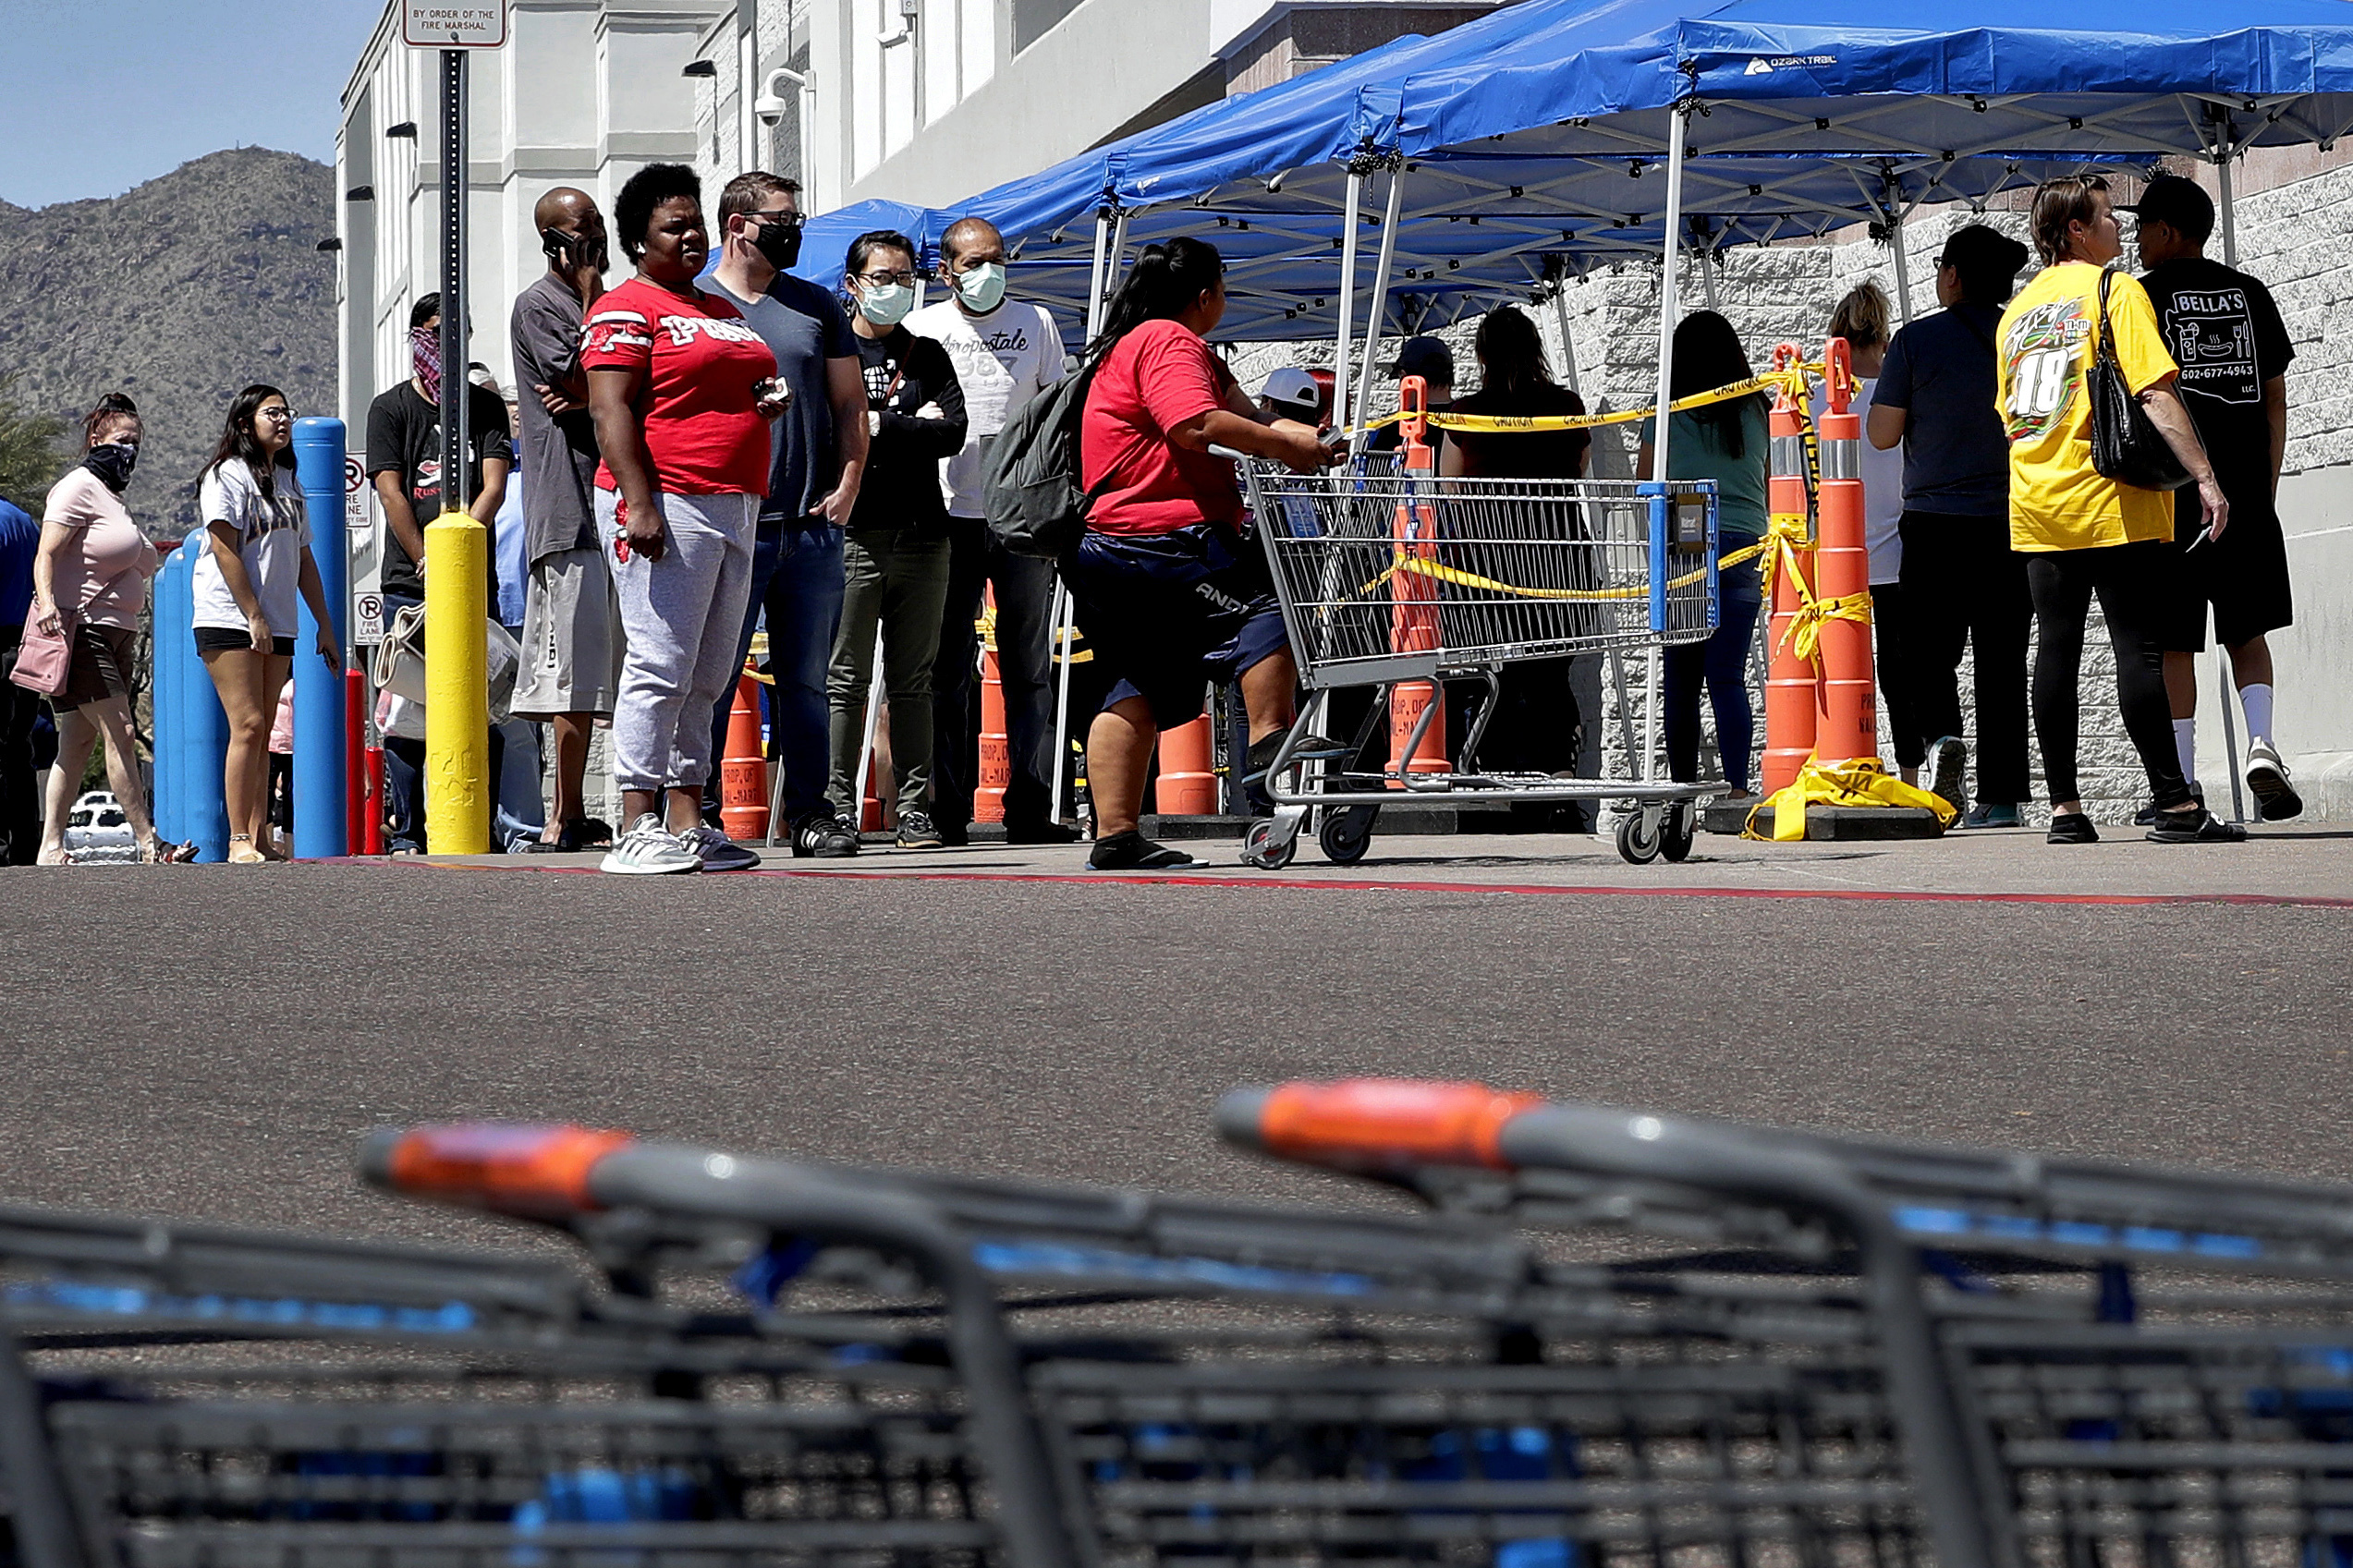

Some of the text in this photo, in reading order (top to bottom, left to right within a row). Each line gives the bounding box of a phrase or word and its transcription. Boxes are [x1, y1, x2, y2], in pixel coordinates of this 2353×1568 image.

[413, 10, 494, 18] BY ORDER OF THE
[421, 21, 486, 30] FIRE MARSHAL
[1770, 55, 1837, 67] OZARK TRAIL
[2178, 294, 2244, 313] BELLA'S
[954, 354, 1018, 378] 987
[2015, 347, 2069, 417] 18
[345, 494, 359, 504] RE
[347, 504, 361, 515] NE
